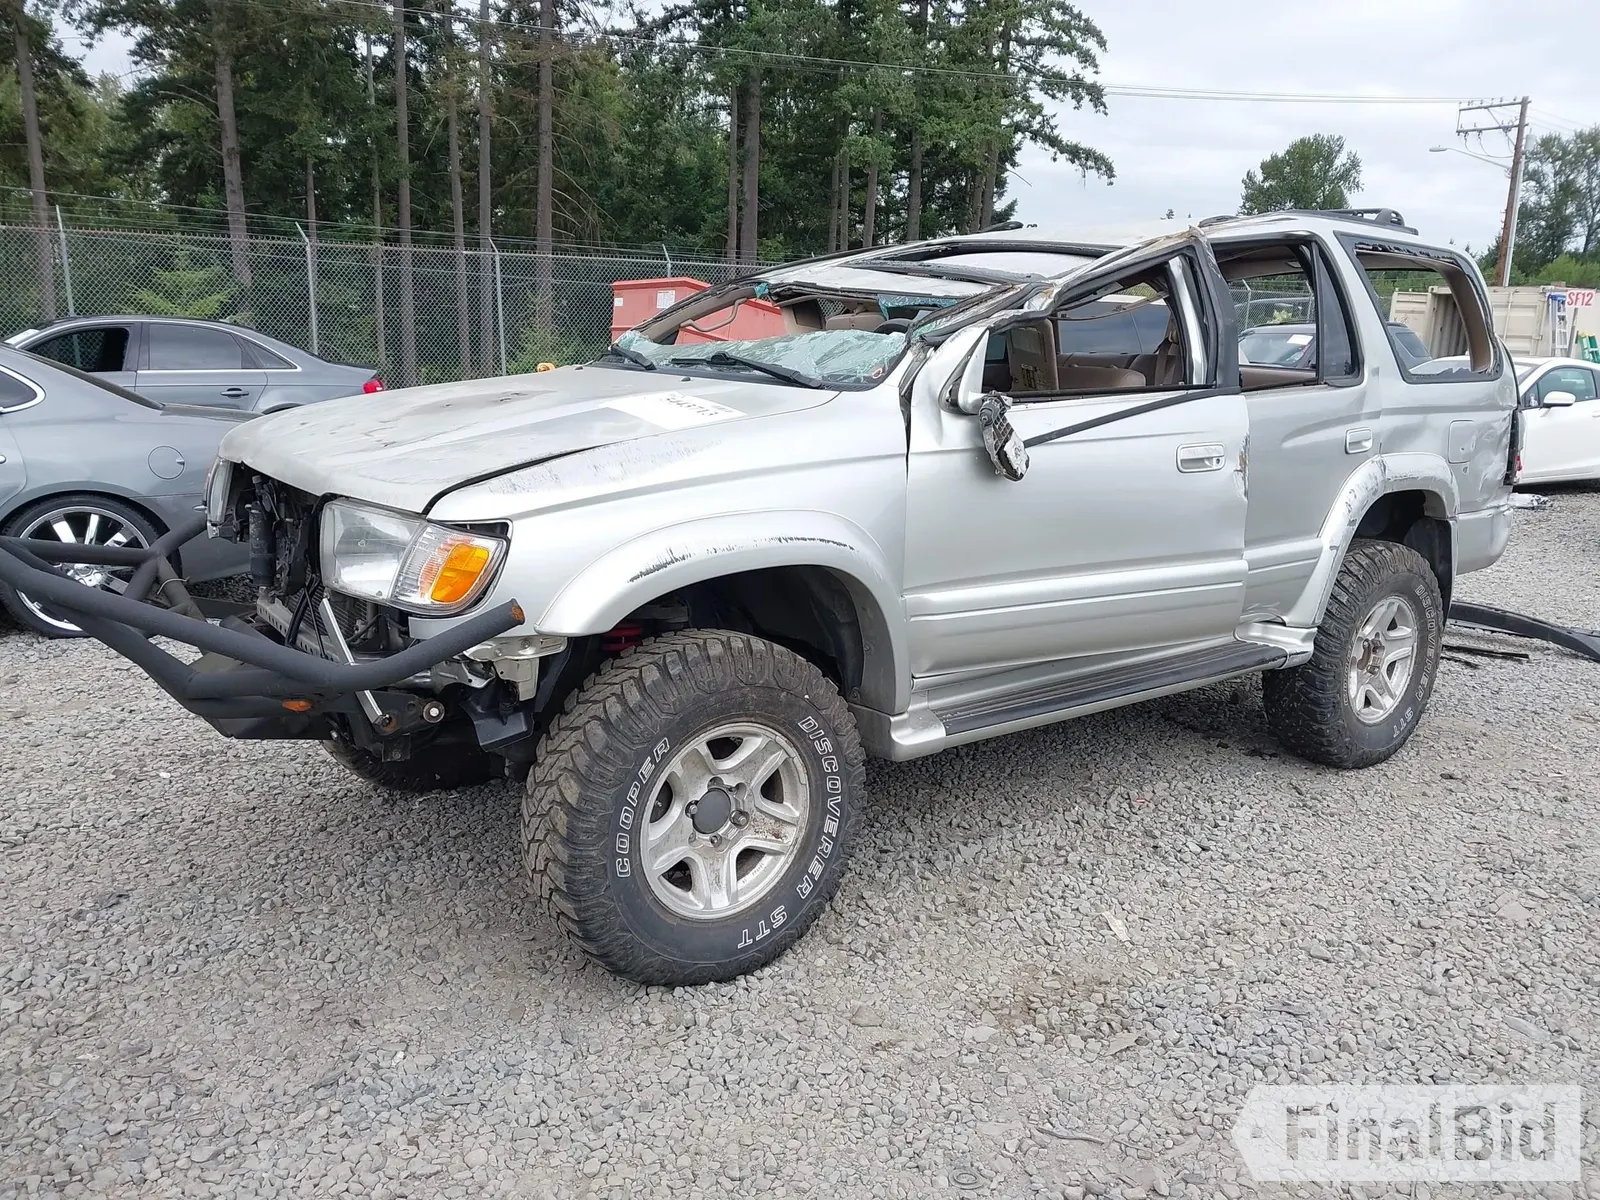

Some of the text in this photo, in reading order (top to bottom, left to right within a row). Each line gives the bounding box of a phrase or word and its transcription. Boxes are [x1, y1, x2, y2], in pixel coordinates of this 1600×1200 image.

[1567, 291, 1594, 306] SF12
[1393, 584, 1435, 738] DISCOVERER STT
[616, 716, 842, 949] COOPER DISCOVERER STT
